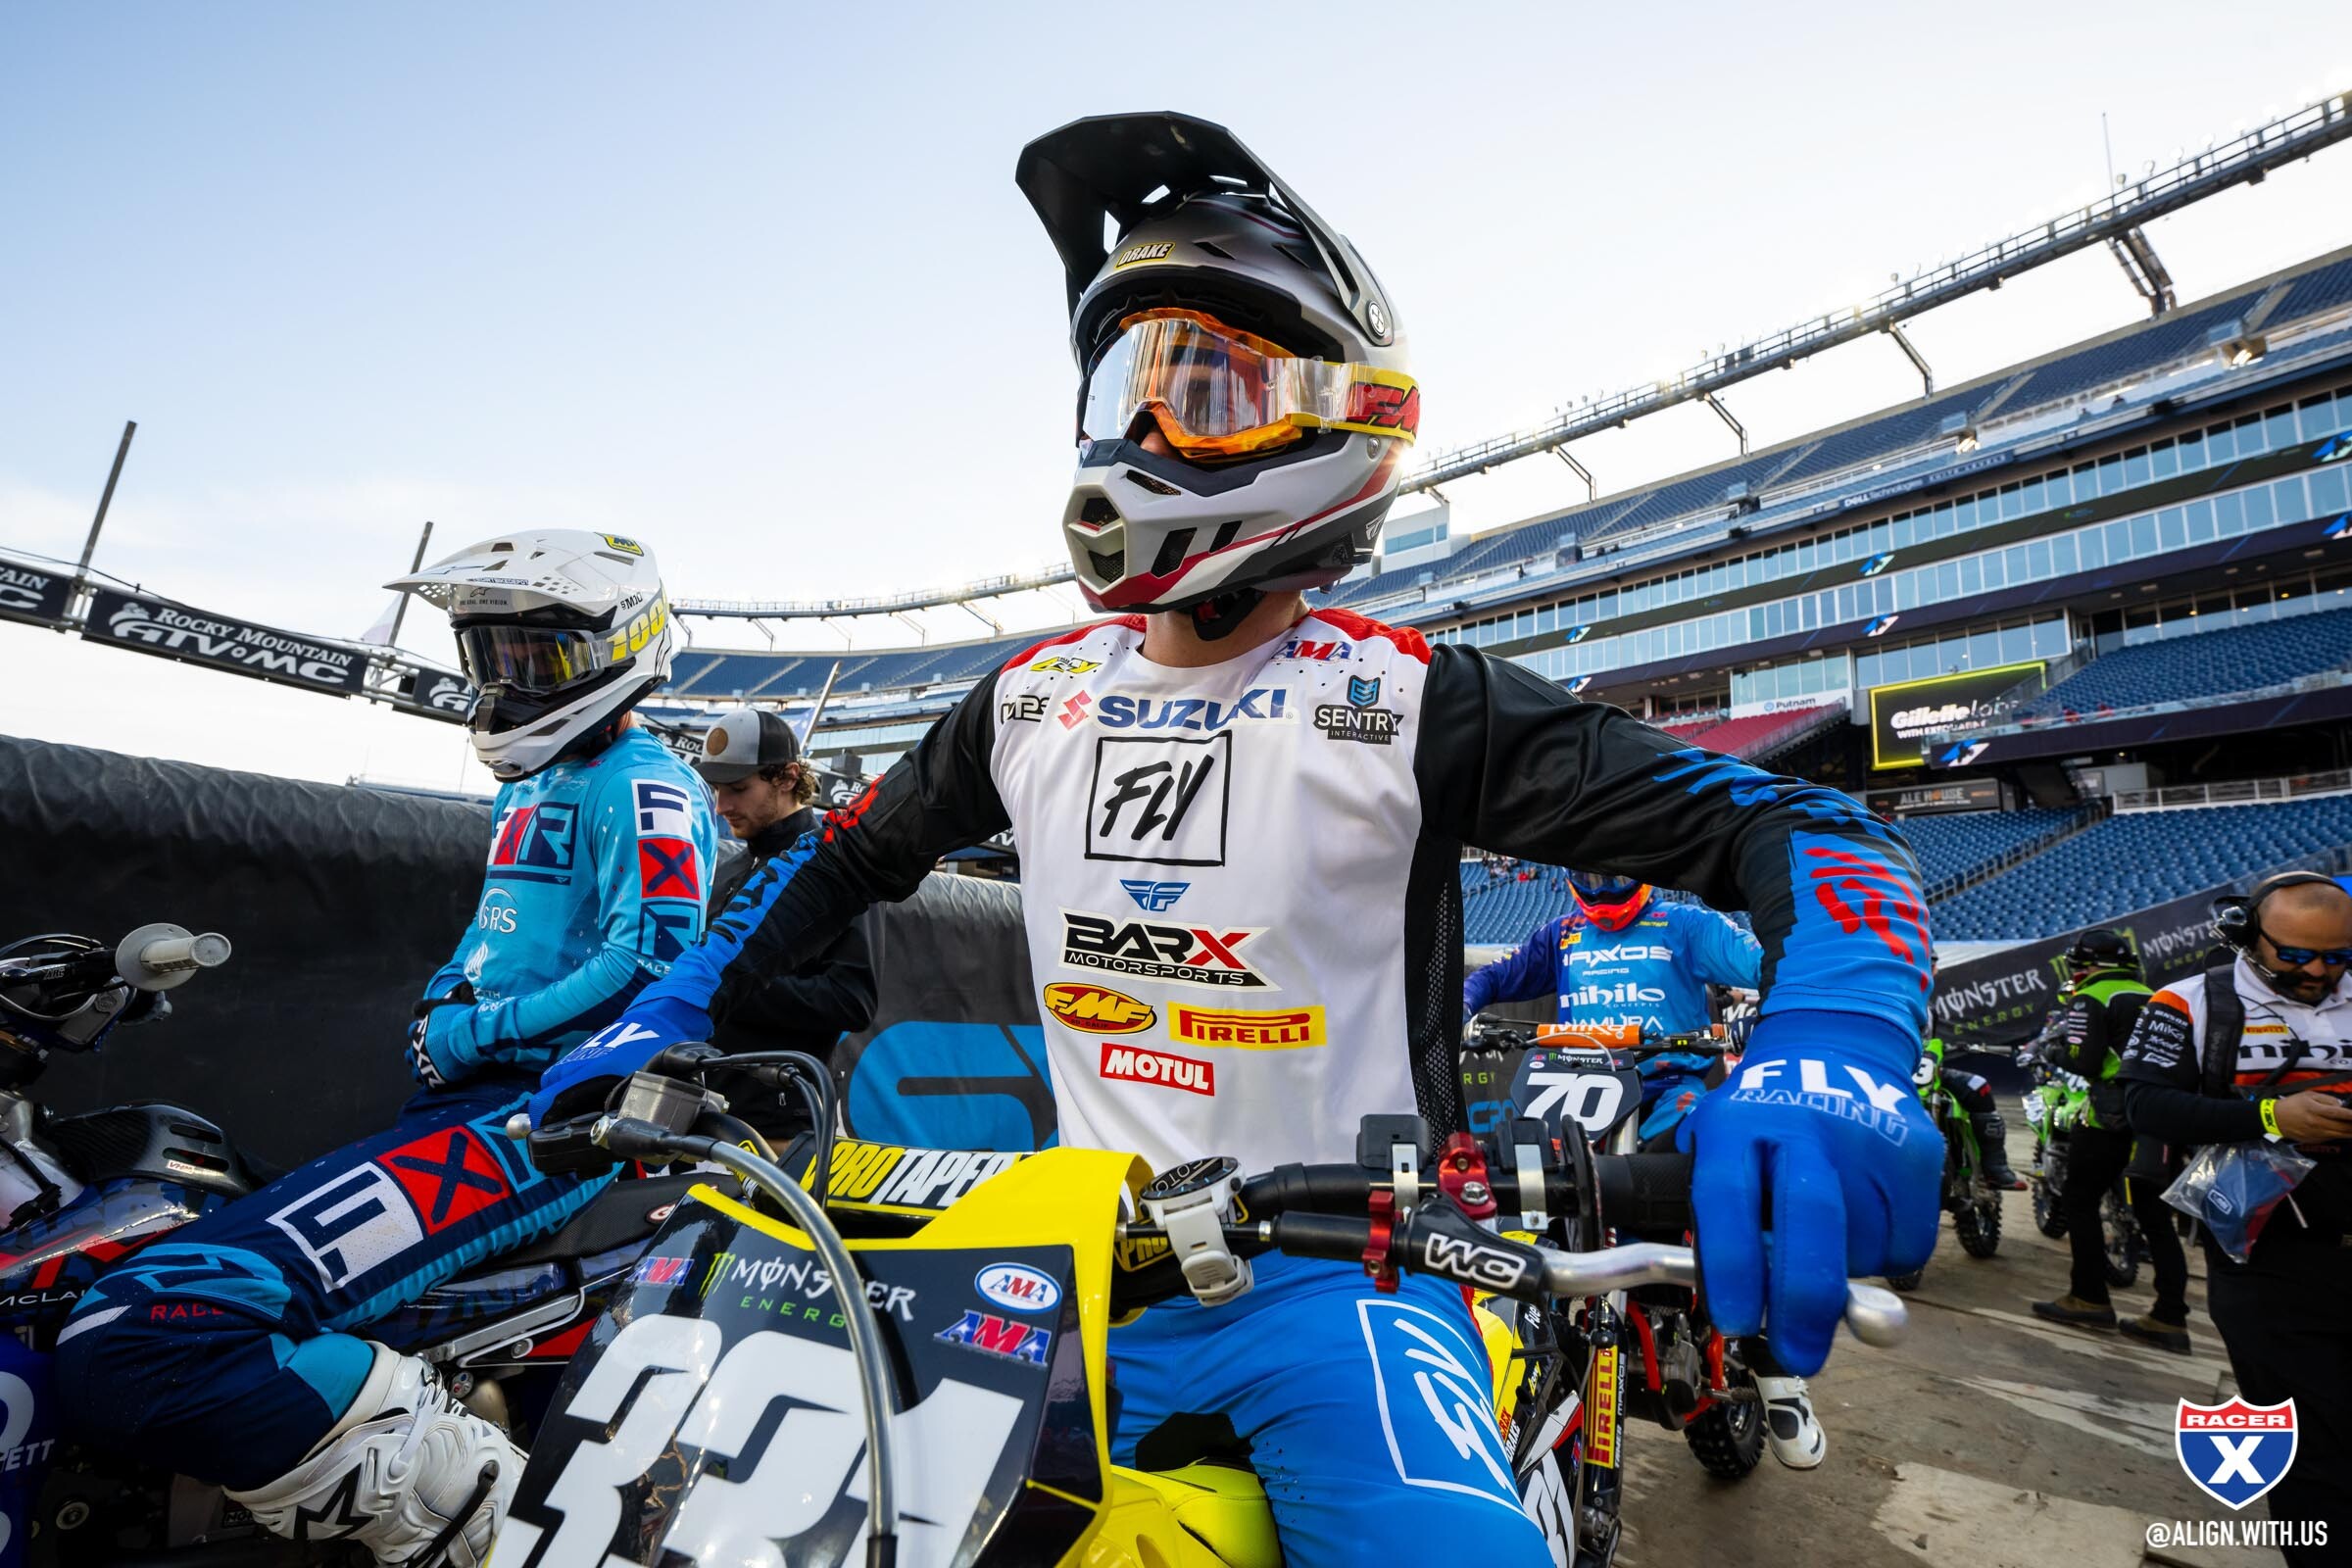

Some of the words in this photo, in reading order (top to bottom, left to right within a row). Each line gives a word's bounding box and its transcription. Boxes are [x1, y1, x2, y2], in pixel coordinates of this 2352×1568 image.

[1117, 243, 1171, 266] DRAKE
[0, 566, 48, 590] AIN
[154, 608, 235, 638] ROCKY
[235, 627, 353, 667] MOUNTAIN
[1271, 640, 1353, 661] AMA
[1098, 688, 1287, 732] SUZUKI
[1317, 707, 1399, 733] SENTRY
[1776, 698, 1816, 709] Putnam
[1331, 730, 1390, 742] INTERACTIVE
[1100, 754, 1214, 841] FLY
[1063, 912, 1251, 970] BARX
[1068, 952, 1246, 986] MOTORSPORTS
[1045, 987, 1153, 1023] FMF
[1559, 982, 1666, 1008] nihilo
[1179, 1008, 1311, 1045] PIRELLI
[1954, 1003, 2035, 1035] ENERGY
[1104, 1049, 1210, 1091] MOTUL
[1739, 1058, 1909, 1115] FLY
[1523, 1071, 1624, 1132] 70
[1729, 1089, 1909, 1147] RACING
[626, 1256, 696, 1287] AMA
[990, 1274, 1048, 1302] AMA
[740, 1296, 849, 1329] ENERG
[933, 1309, 1053, 1366] AMA
